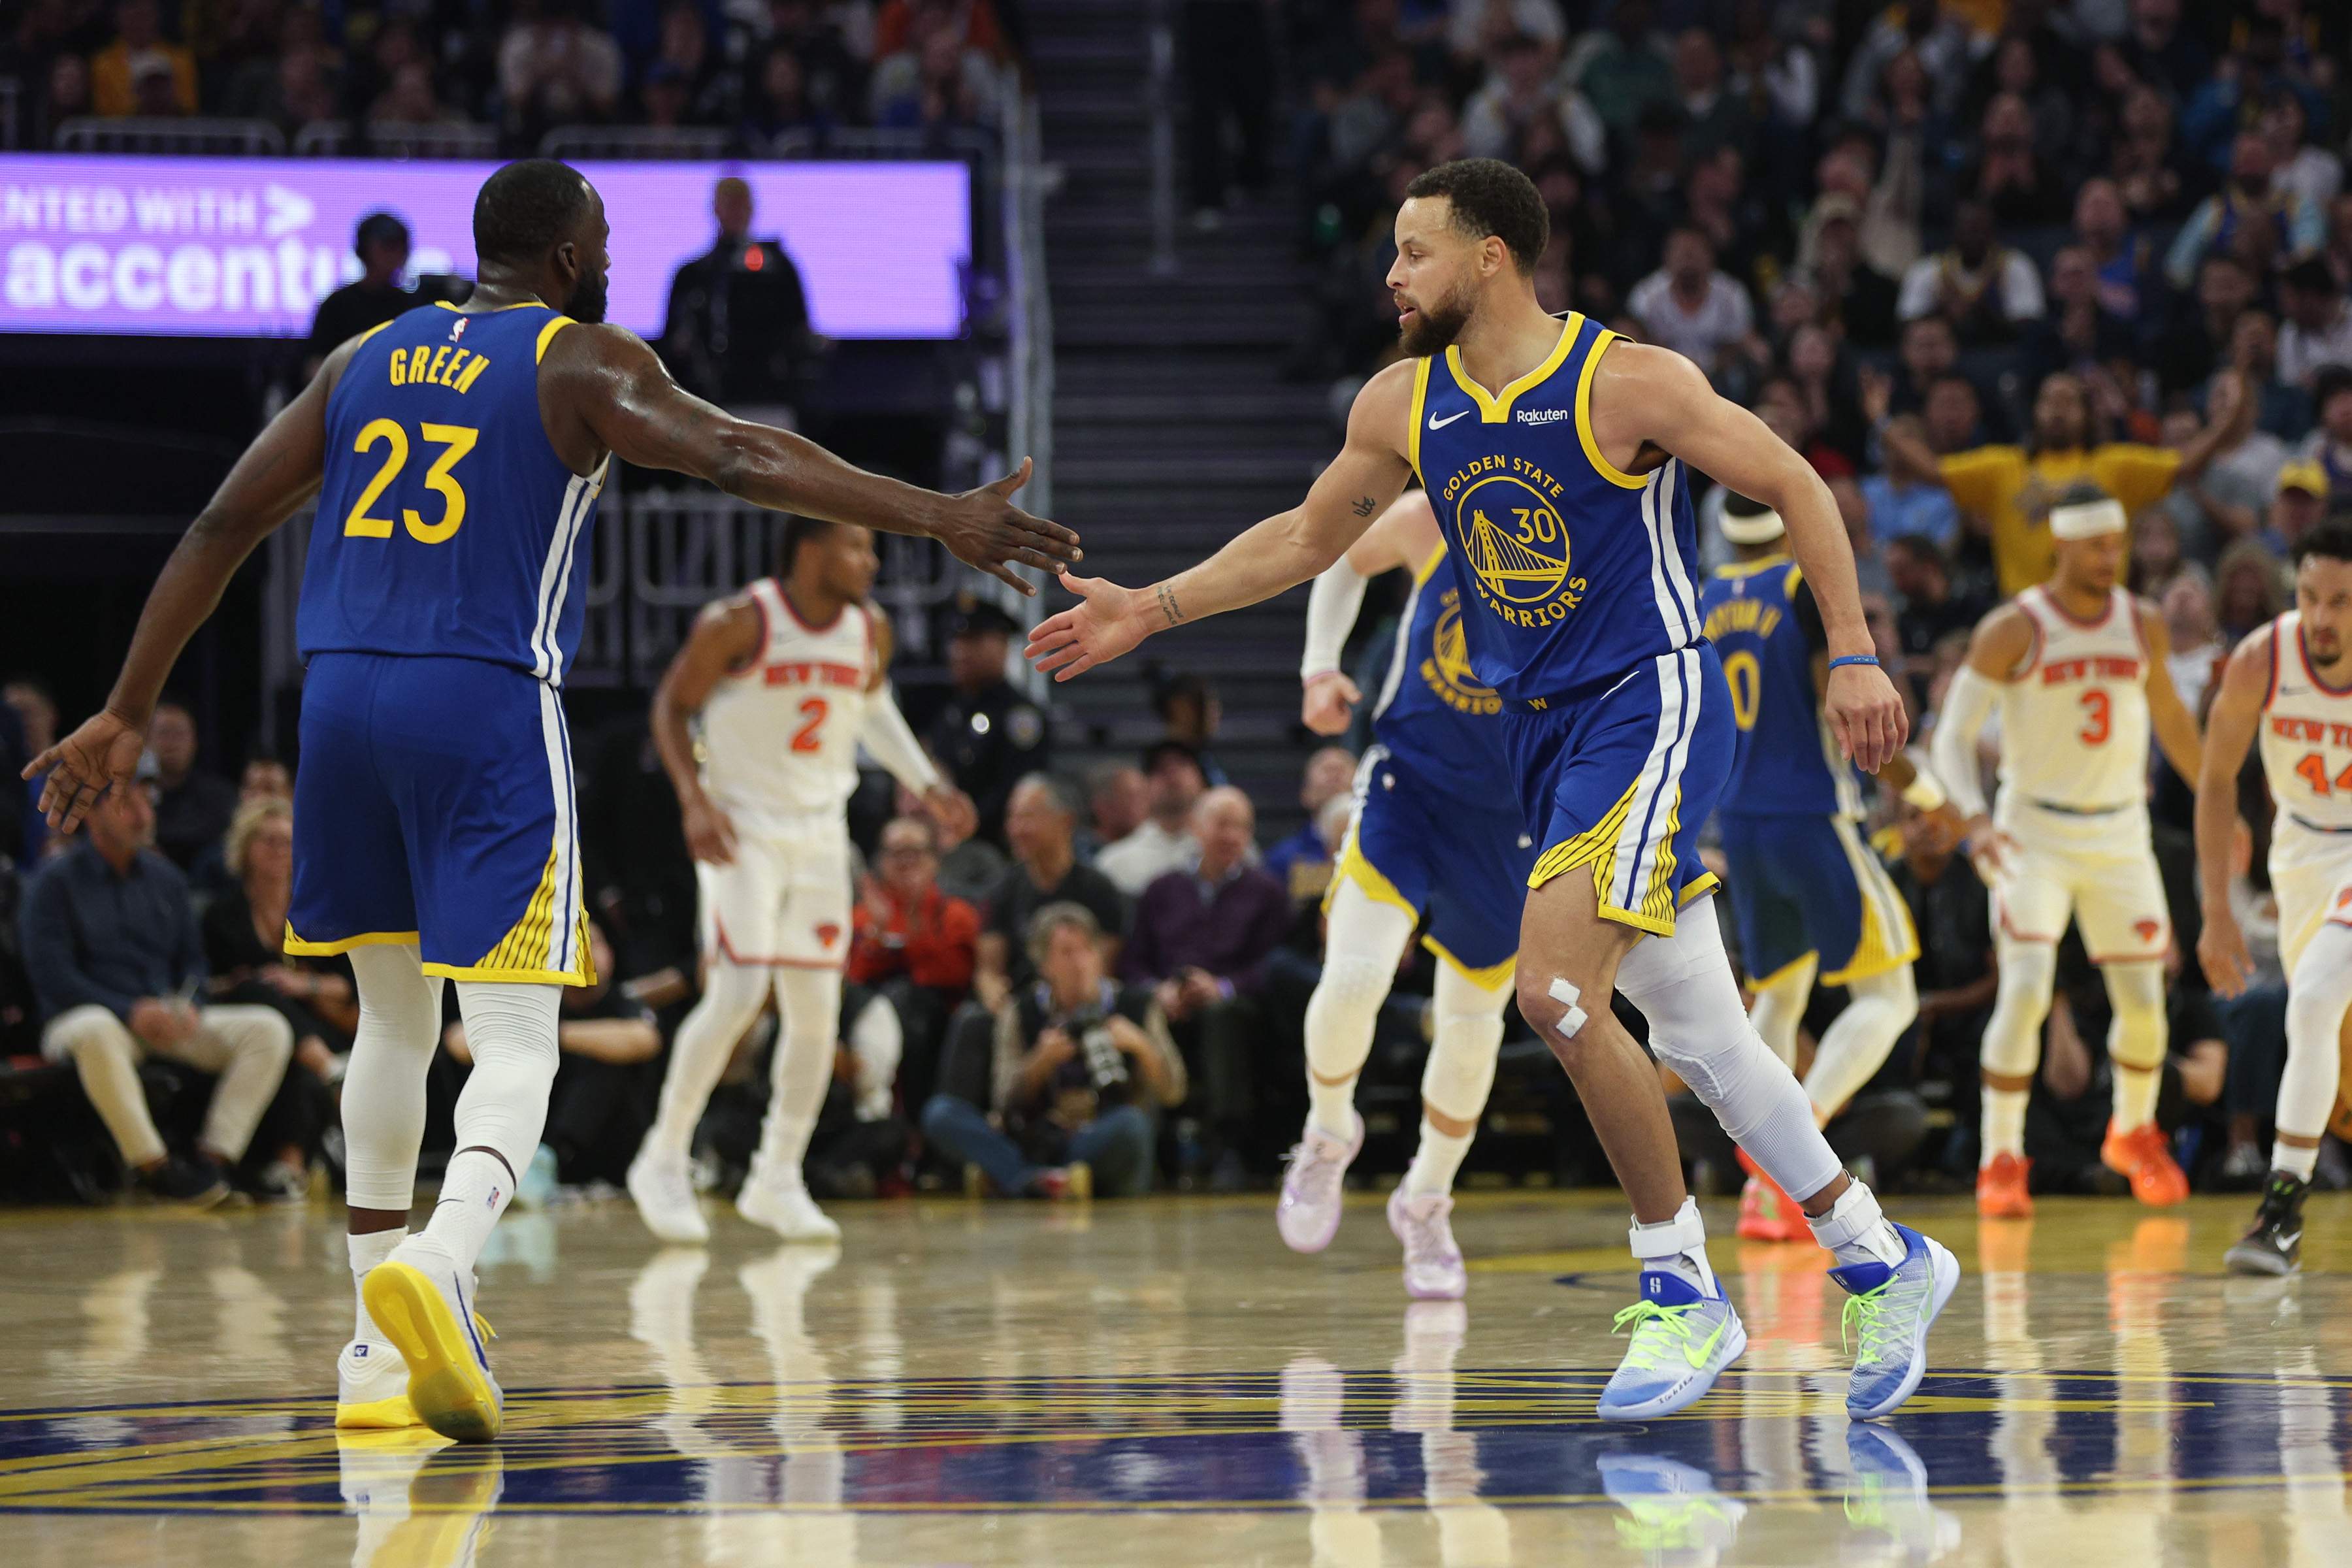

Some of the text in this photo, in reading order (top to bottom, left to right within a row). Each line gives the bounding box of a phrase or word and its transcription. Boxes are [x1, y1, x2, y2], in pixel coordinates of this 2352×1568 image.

[134, 188, 256, 235] WITH
[390, 345, 490, 395] GREEN
[1516, 408, 1568, 426] Rakuten
[344, 417, 480, 545] 23
[1443, 454, 1565, 501] GOLDEN STATE
[1511, 508, 1556, 544] 30
[1475, 576, 1588, 629] WARRIORS
[764, 662, 812, 687] NEW
[1723, 650, 1761, 732] 0
[2042, 659, 2086, 686] NEW
[789, 698, 829, 753] 2
[1527, 696, 1548, 711] W
[2080, 690, 2111, 745] 3
[2272, 717, 2326, 742] NEW
